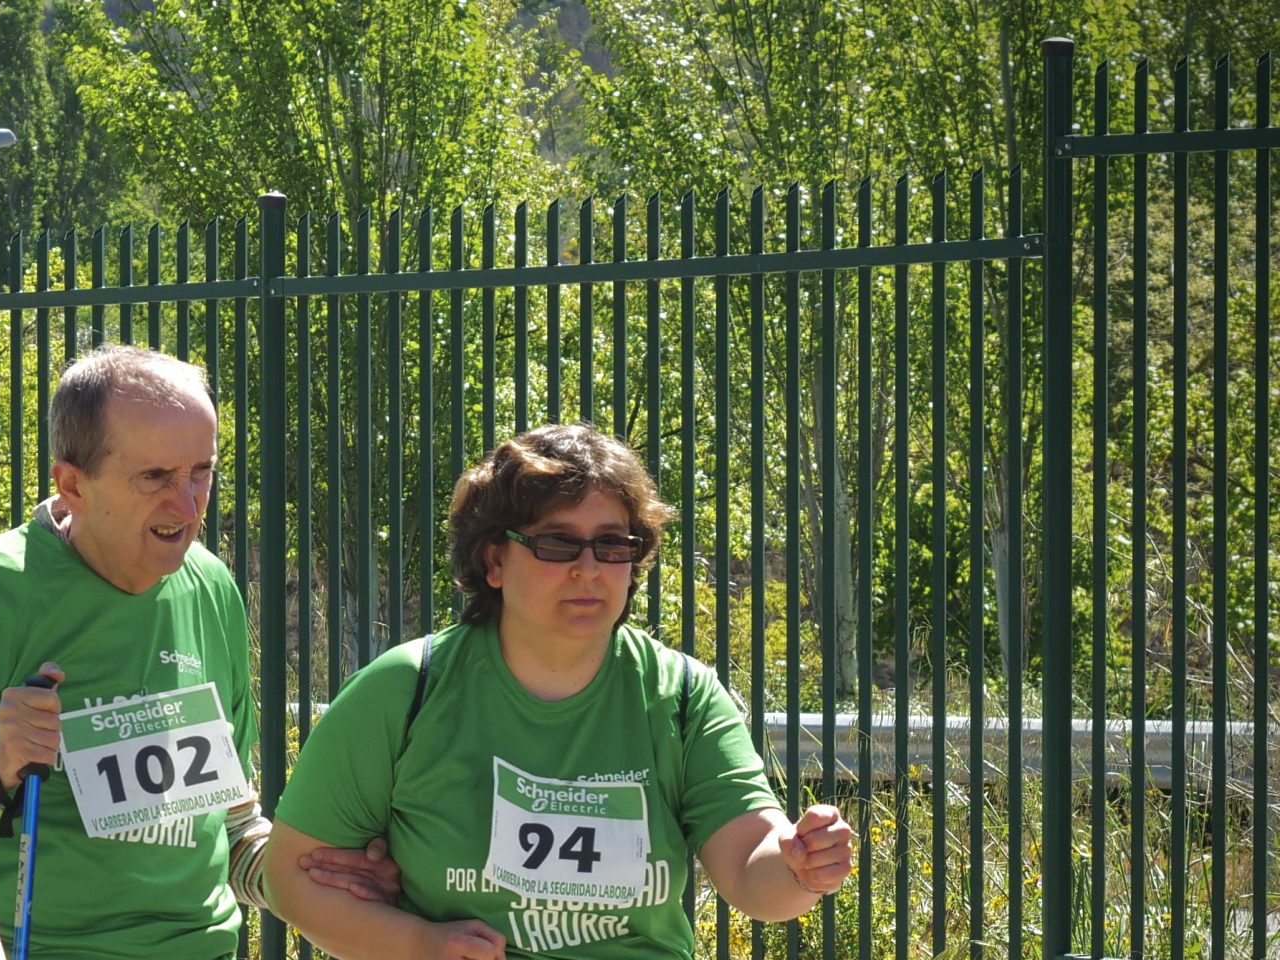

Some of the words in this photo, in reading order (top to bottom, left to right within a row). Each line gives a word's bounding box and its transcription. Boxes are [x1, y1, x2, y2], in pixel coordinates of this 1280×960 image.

[91, 700, 184, 732] Schneider
[135, 714, 187, 734] Electric
[97, 735, 219, 804] 102
[516, 776, 609, 804] Schneider
[92, 818, 99, 831] V
[99, 814, 135, 831] CARRERA
[134, 809, 151, 823] POR
[151, 804, 161, 819] LA
[161, 795, 206, 817] SEGURIDAD
[205, 785, 244, 806] LABORAL
[550, 801, 607, 815] Electric
[518, 822, 601, 873] 94
[446, 867, 476, 892] POR
[496, 866, 521, 886] CARRERA
[521, 878, 536, 894] POR
[537, 881, 549, 894] LA
[550, 881, 598, 897] SEGURIDAD
[508, 910, 629, 953] LABORAL
